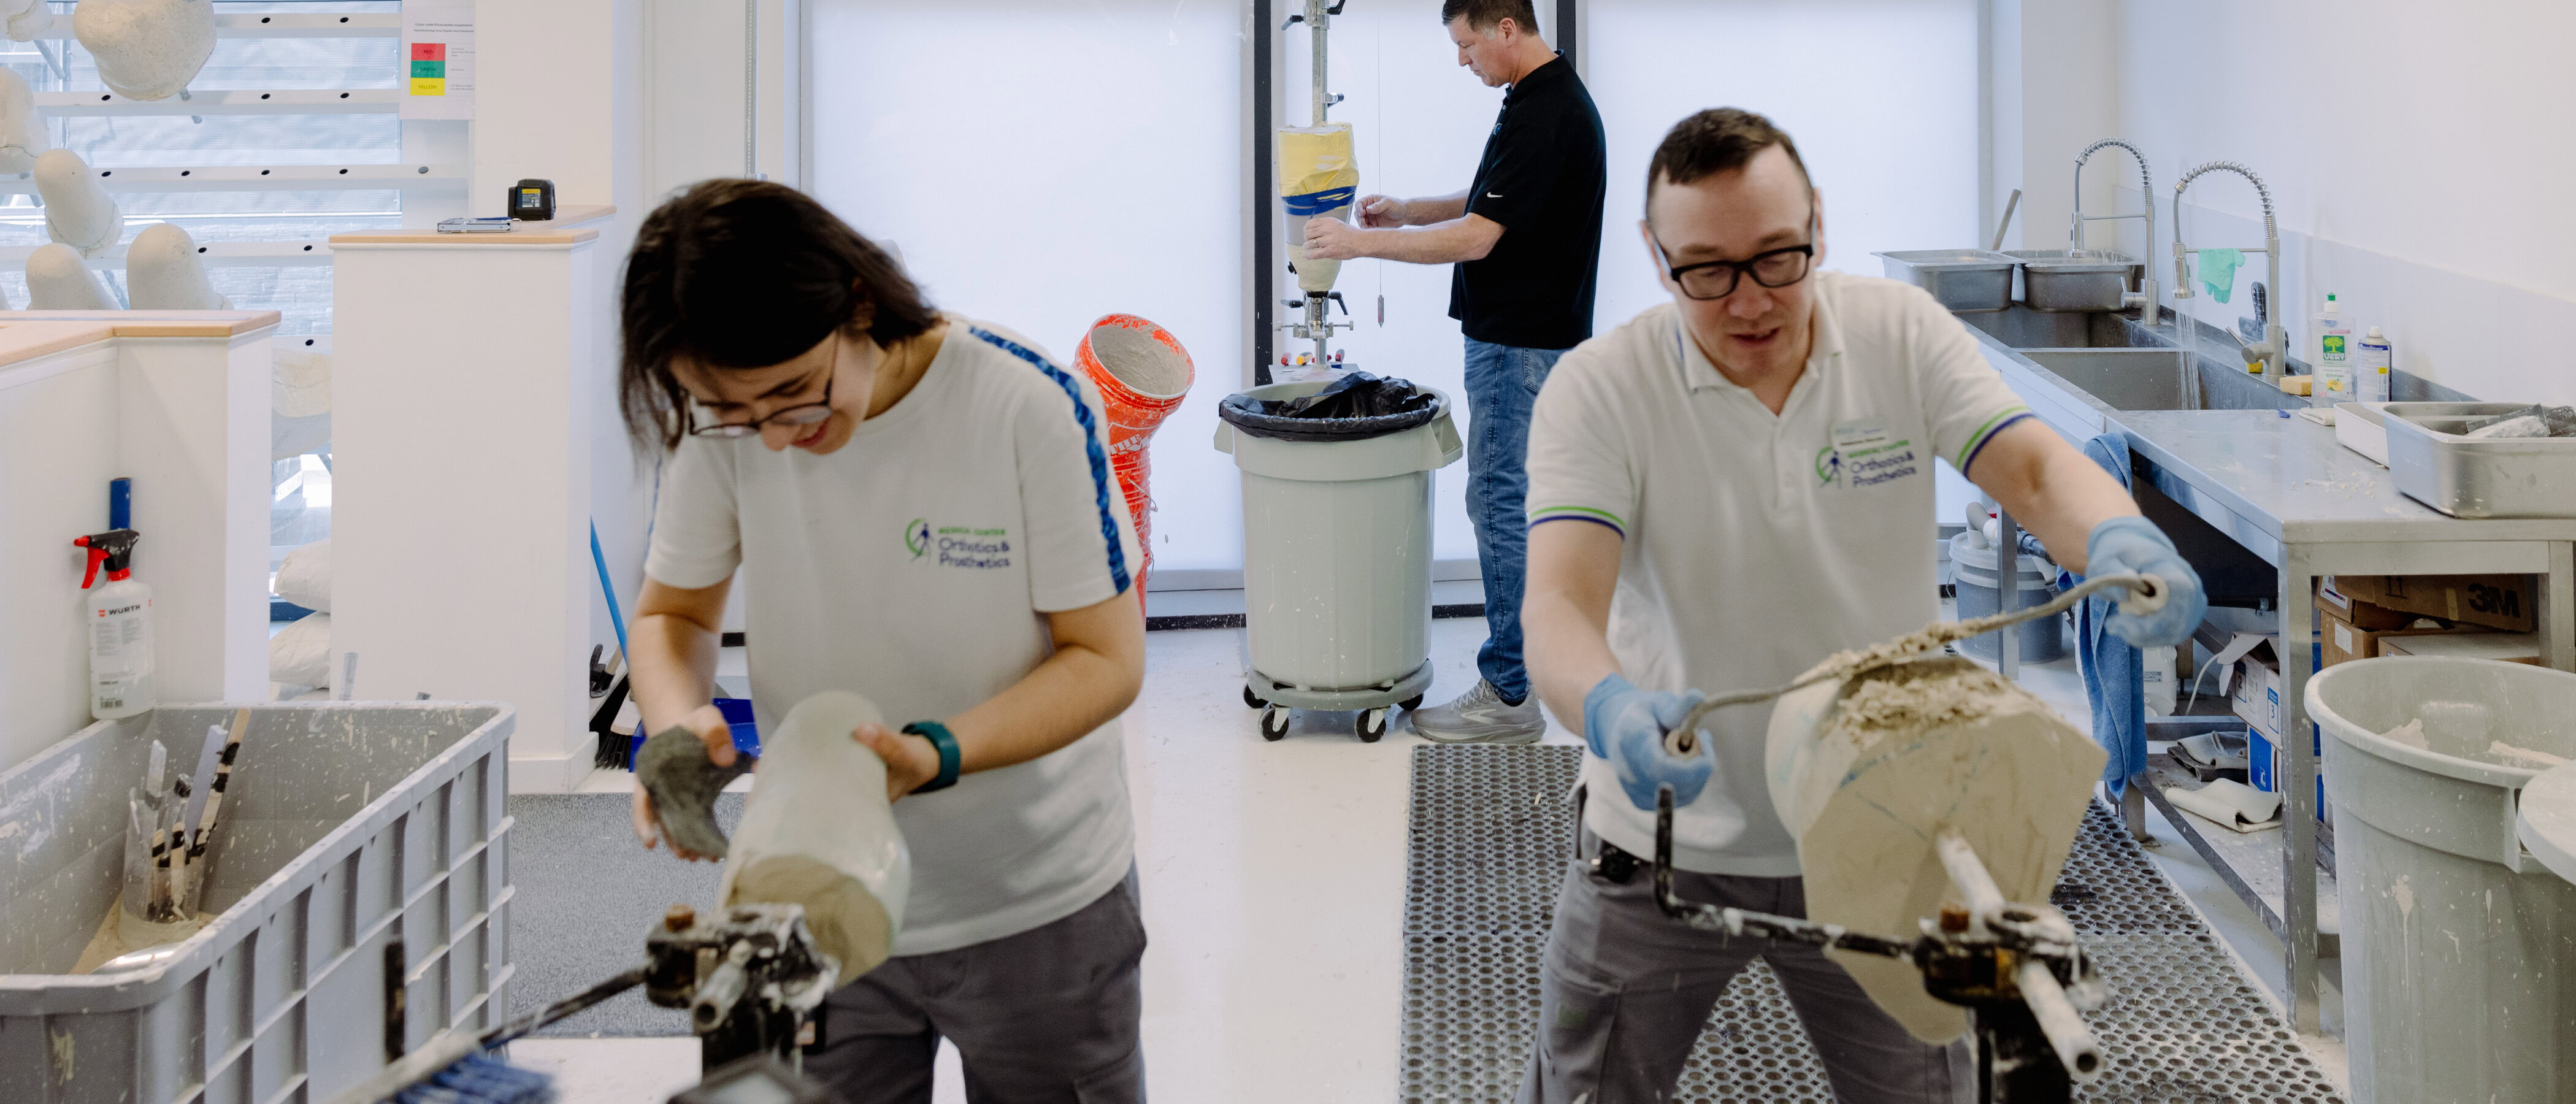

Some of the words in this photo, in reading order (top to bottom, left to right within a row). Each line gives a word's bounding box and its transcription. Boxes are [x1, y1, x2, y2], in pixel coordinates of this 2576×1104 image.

[1853, 466, 1917, 488] Prosthetics
[939, 552, 1011, 569] Prosthetics
[2467, 583, 2520, 618] 3M
[2238, 675, 2242, 689] 2
[2271, 704, 2275, 718] 3
